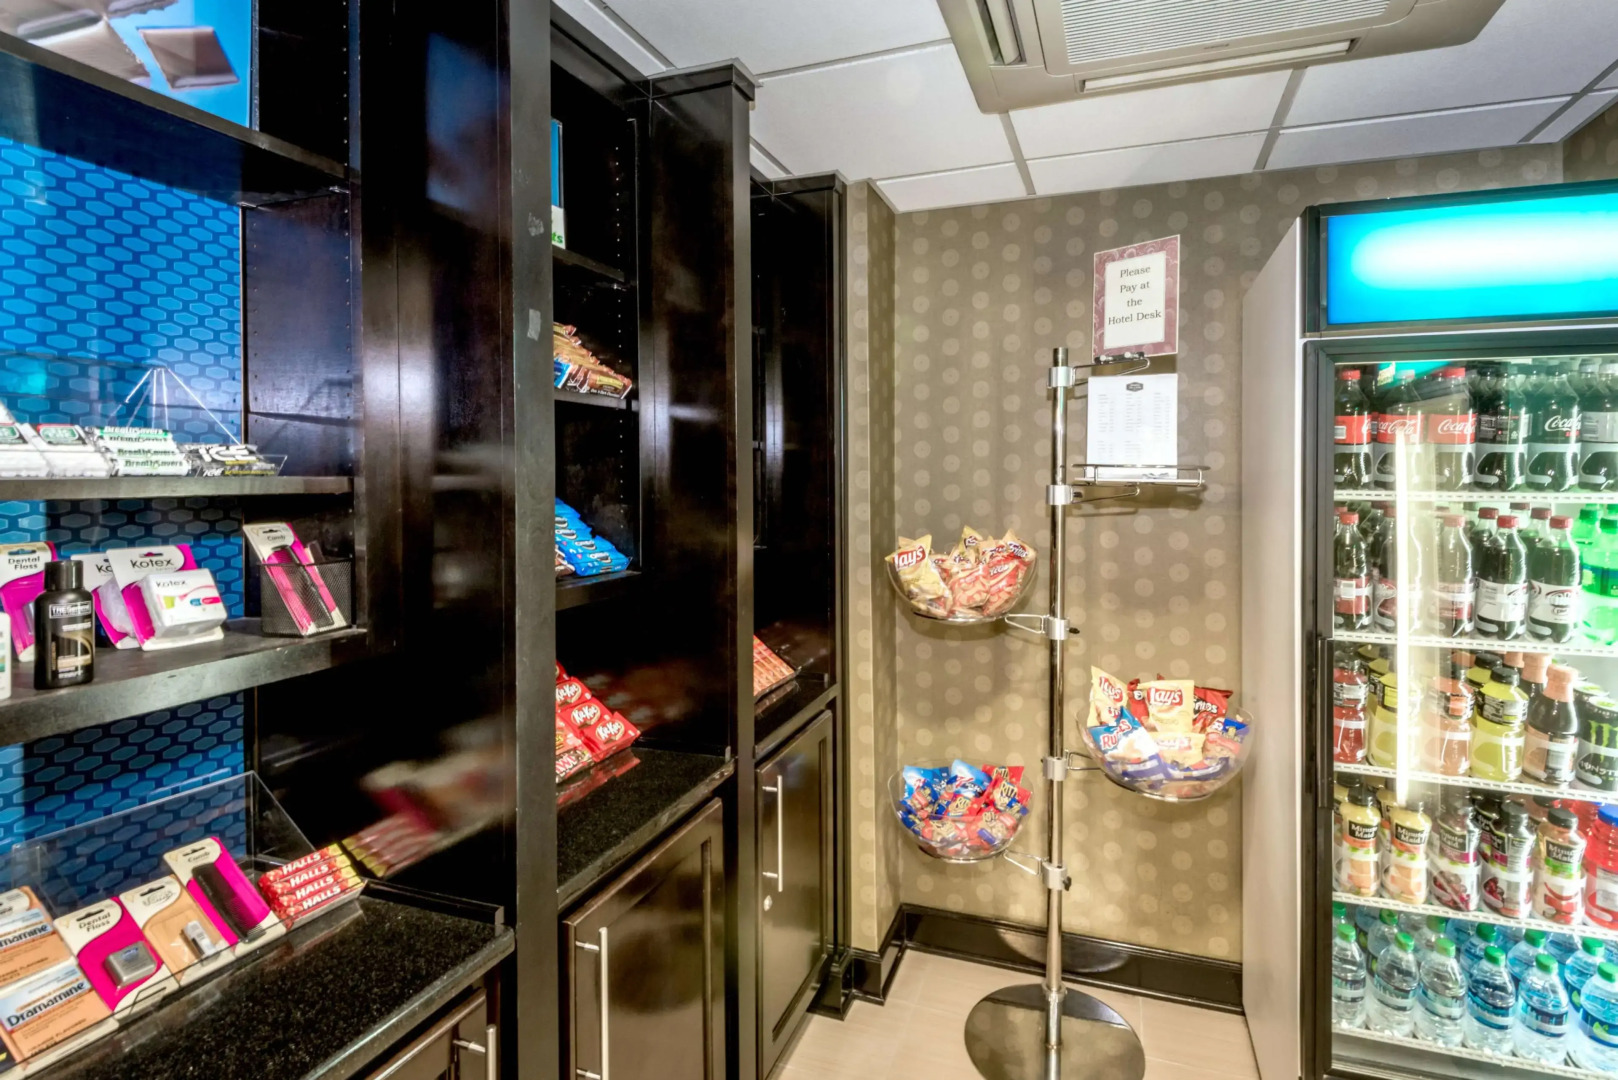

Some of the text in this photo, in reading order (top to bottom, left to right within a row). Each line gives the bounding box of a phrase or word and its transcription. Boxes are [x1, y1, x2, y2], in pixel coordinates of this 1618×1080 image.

[1120, 267, 1151, 278] Please
[1120, 281, 1150, 294] Pay at
[1127, 298, 1143, 307] the
[1108, 309, 1162, 325] Hotel Desk
[8, 556, 41, 565] Dental
[1149, 687, 1183, 706] Lay's
[1351, 823, 1378, 834] Minute
[1355, 830, 1375, 838] Maid
[281, 852, 321, 875] HALLS
[289, 864, 329, 888] HALLS
[295, 875, 334, 899] HALLS
[302, 885, 341, 910] HALLS
[78, 912, 111, 929] Dental
[86, 920, 110, 932] Floss
[7, 981, 85, 1027] Dramamine
